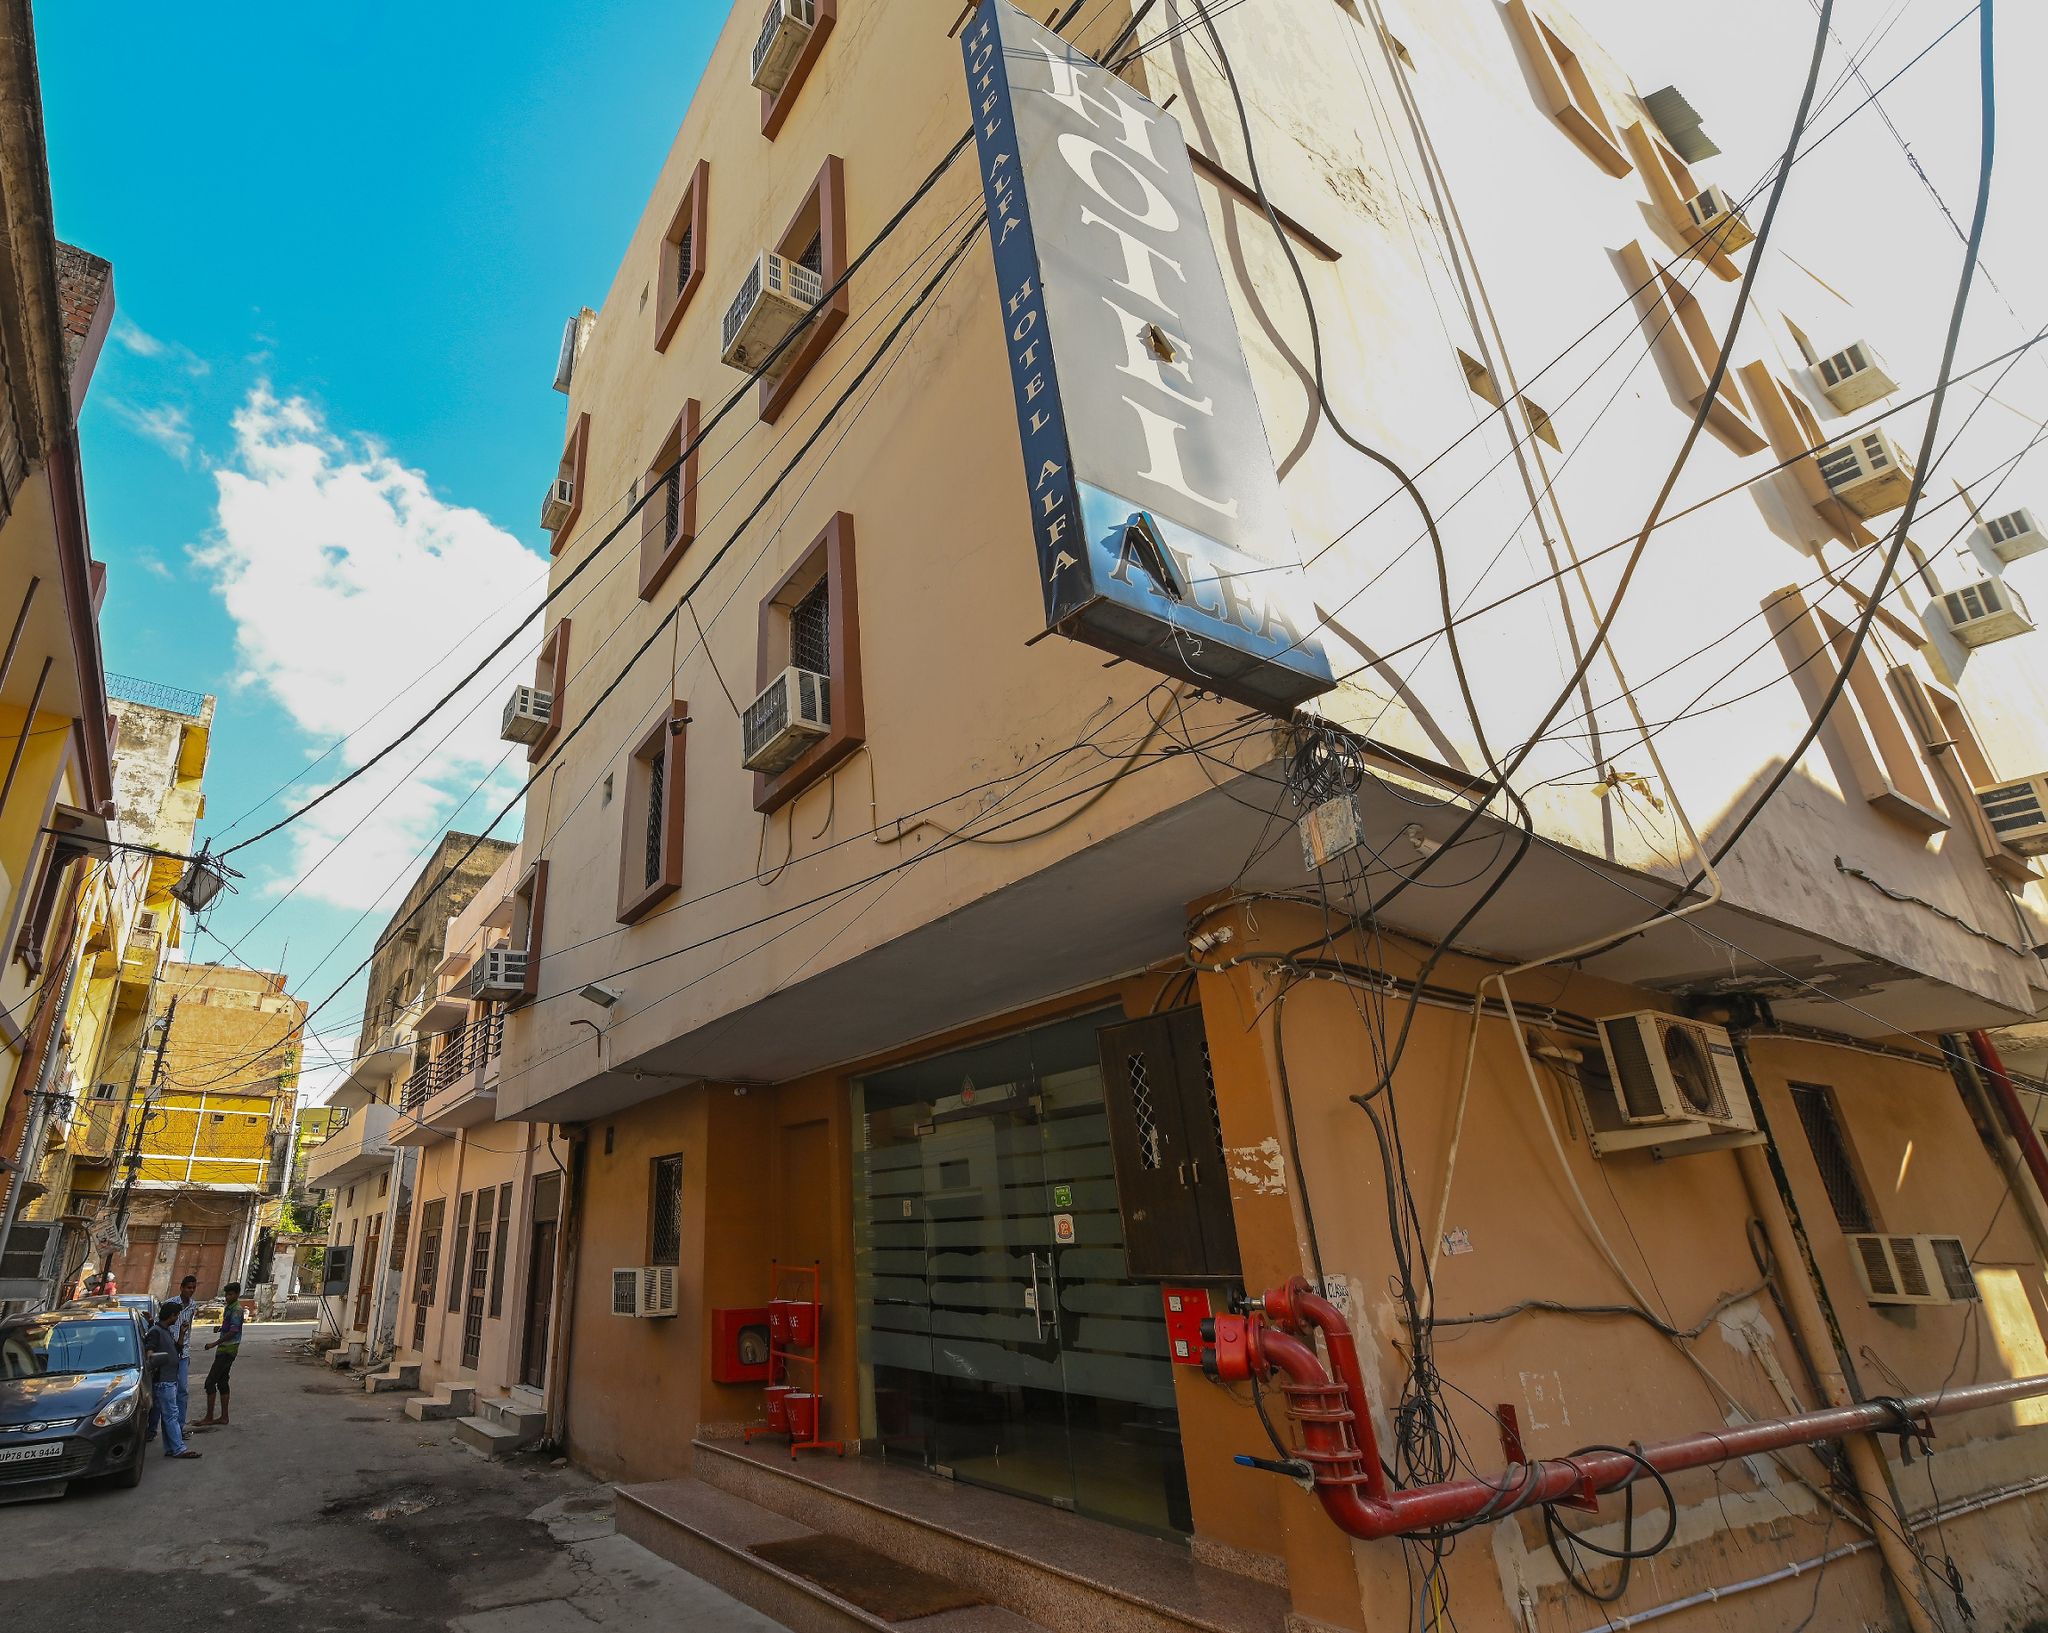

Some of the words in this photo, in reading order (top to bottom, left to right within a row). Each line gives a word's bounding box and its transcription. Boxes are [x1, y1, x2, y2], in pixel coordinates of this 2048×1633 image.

[968, 19, 1001, 142] HOTEL
[988, 153, 1021, 248] ALFA
[1007, 276, 1050, 436] HOTEL
[1036, 459, 1079, 582] ALFA
[1031, 38, 1238, 519] HOTEL
[1099, 518, 1314, 658] ALFA
[24, 1450, 37, 1458] CX
